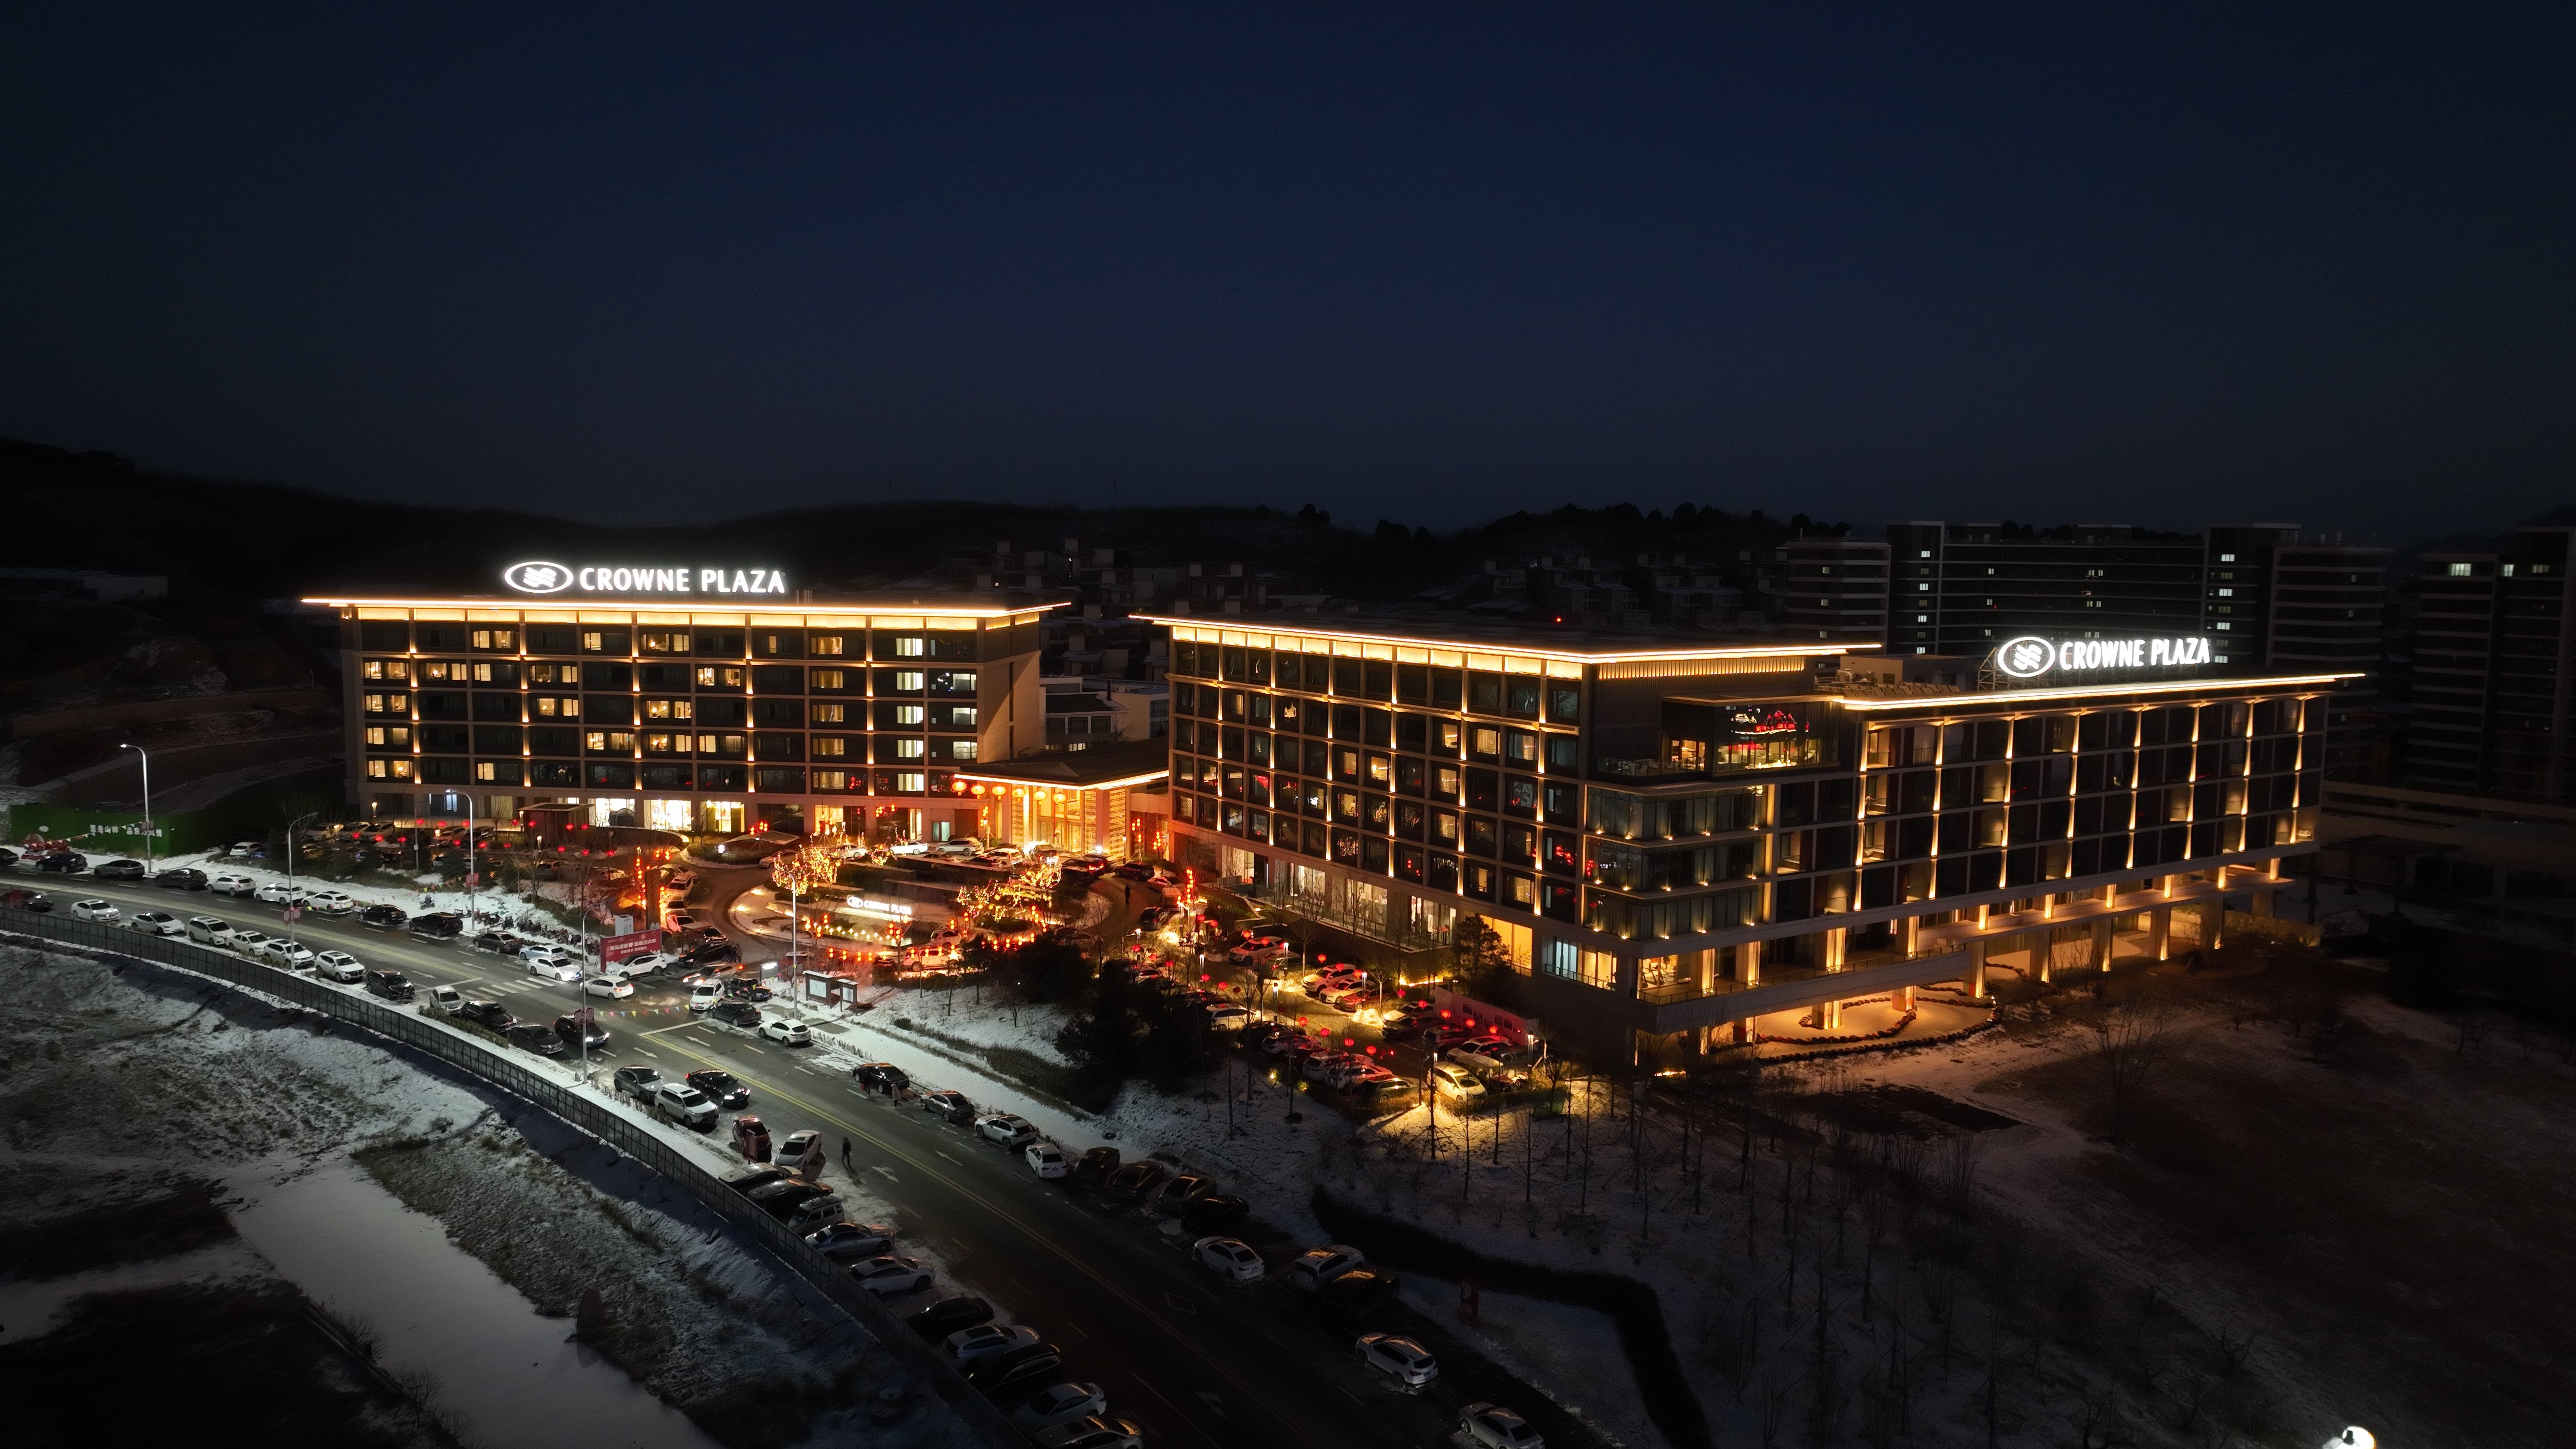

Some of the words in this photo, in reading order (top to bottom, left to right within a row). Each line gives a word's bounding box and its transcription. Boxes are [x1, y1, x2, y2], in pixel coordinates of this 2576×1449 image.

[580, 567, 690, 591] CROWNE
[702, 569, 785, 593] PLAZA
[2059, 639, 2146, 670] CROWNE
[2151, 638, 2210, 666] PLAZA
